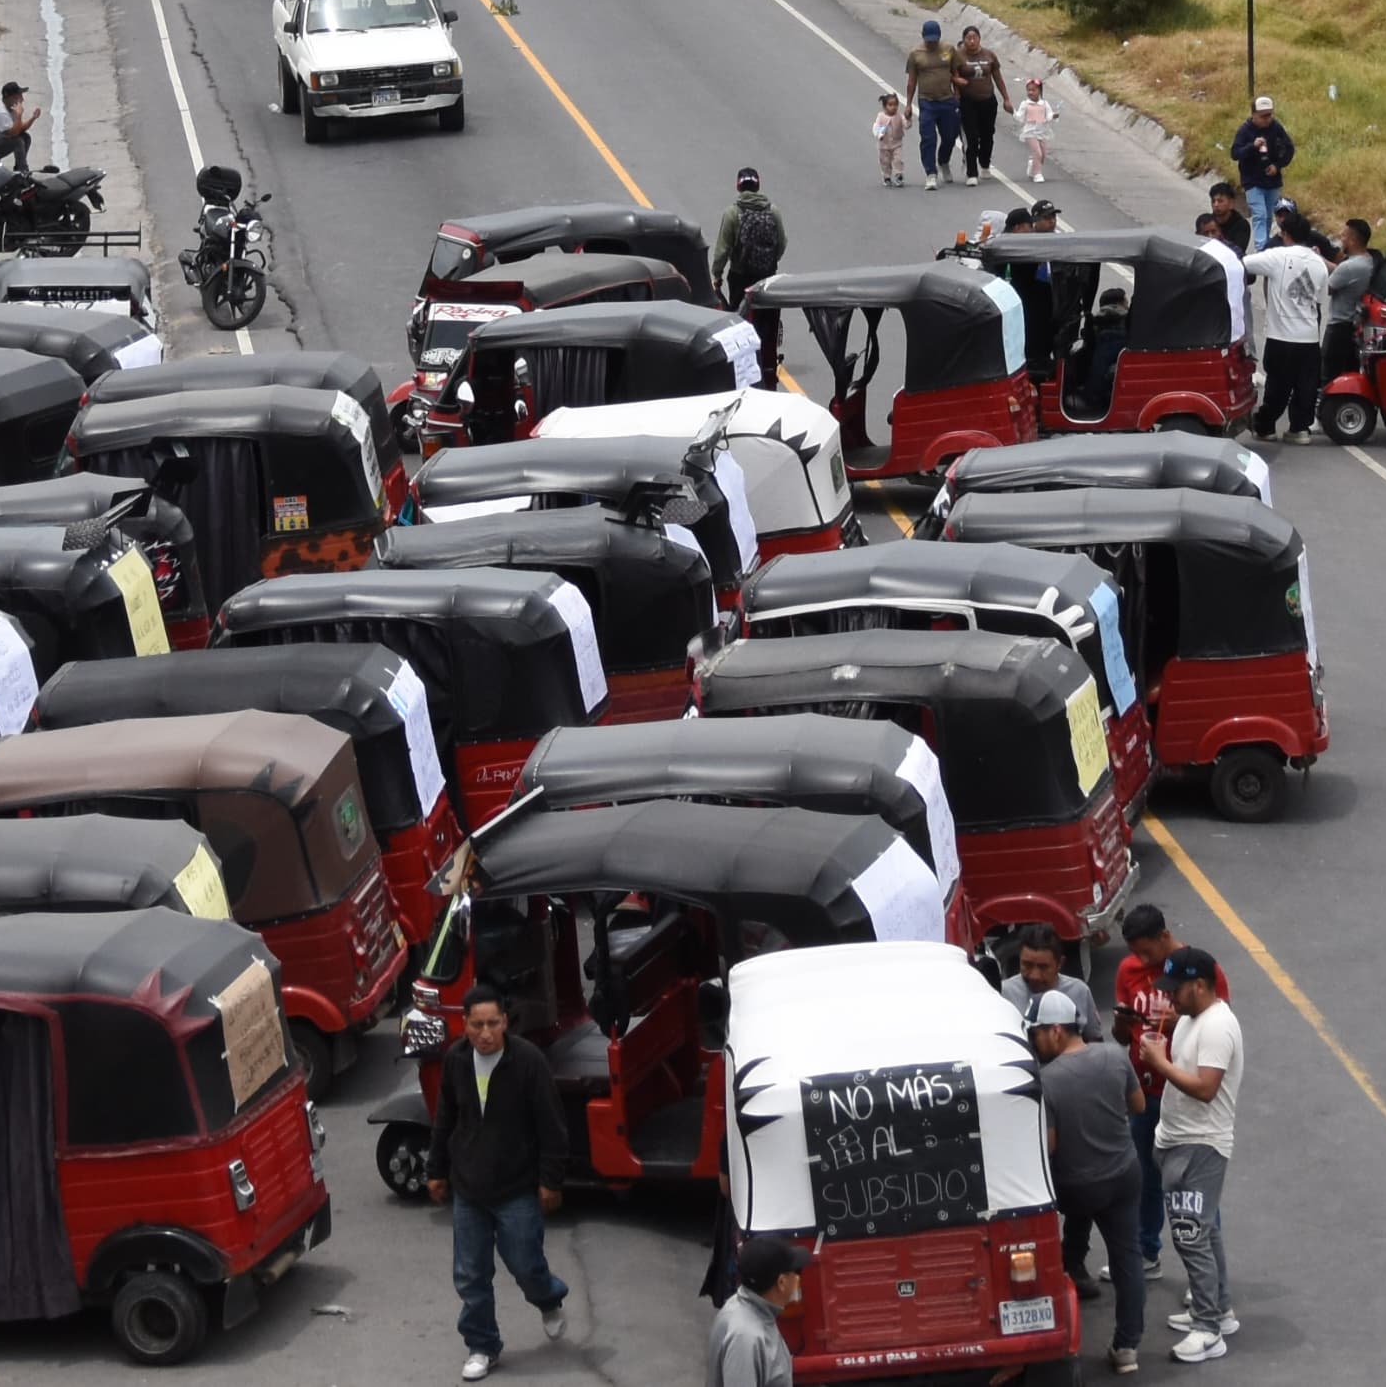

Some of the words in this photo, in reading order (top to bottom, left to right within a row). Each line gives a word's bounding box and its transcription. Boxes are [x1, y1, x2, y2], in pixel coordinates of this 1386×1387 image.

[436, 305, 510, 319] Racing
[829, 1084, 874, 1125] NO
[886, 1068, 954, 1113] MÁS
[872, 1124, 913, 1162] AL
[821, 1169, 968, 1221] SUBSIDIO
